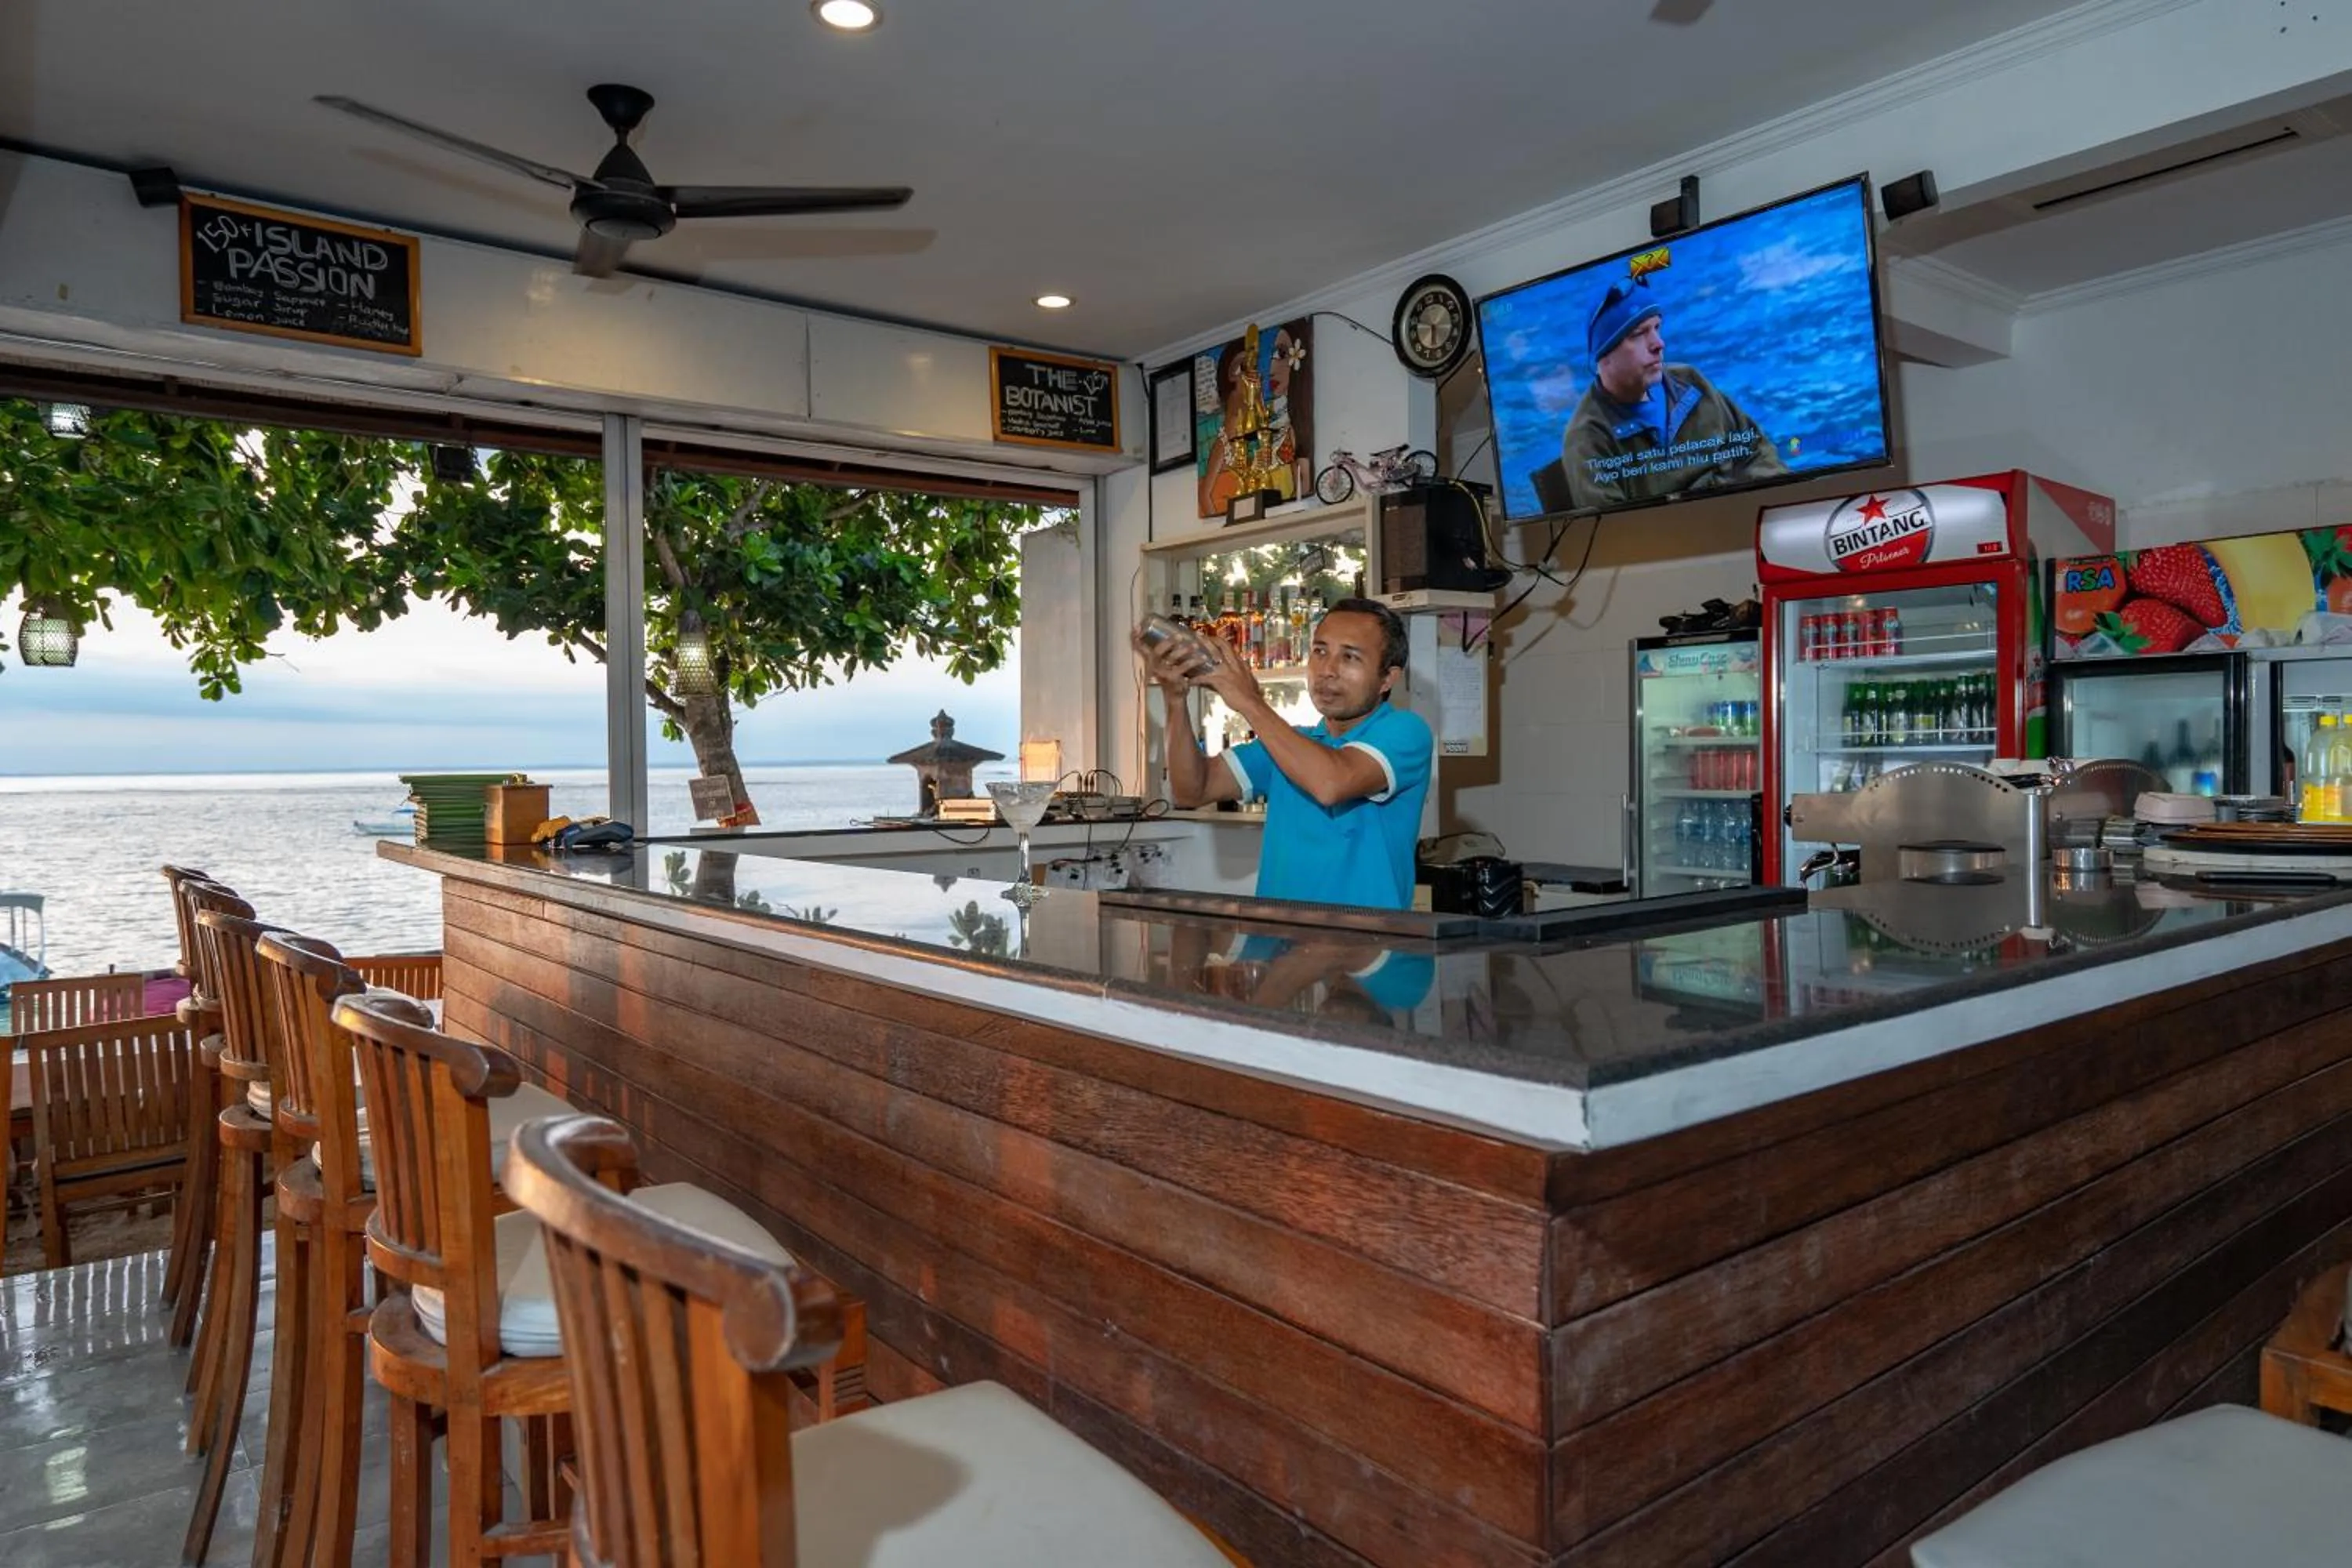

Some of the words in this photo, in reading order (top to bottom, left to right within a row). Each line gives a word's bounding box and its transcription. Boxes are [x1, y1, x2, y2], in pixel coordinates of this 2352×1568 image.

[254, 221, 388, 270] ISLAND
[227, 248, 376, 300] PASSION
[1024, 363, 1078, 391] THE
[1004, 385, 1098, 418] BOTANIST
[1585, 452, 1634, 470] Tinggal
[1637, 447, 1665, 459] satu
[1669, 437, 1725, 456] pelacak
[1594, 471, 1619, 484] Ayo
[1622, 466, 1647, 478] beri
[1650, 458, 1683, 474] kami
[1687, 452, 1709, 466] hiu
[1833, 510, 1925, 556] BINTANG
[2066, 566, 2116, 593] RSA
